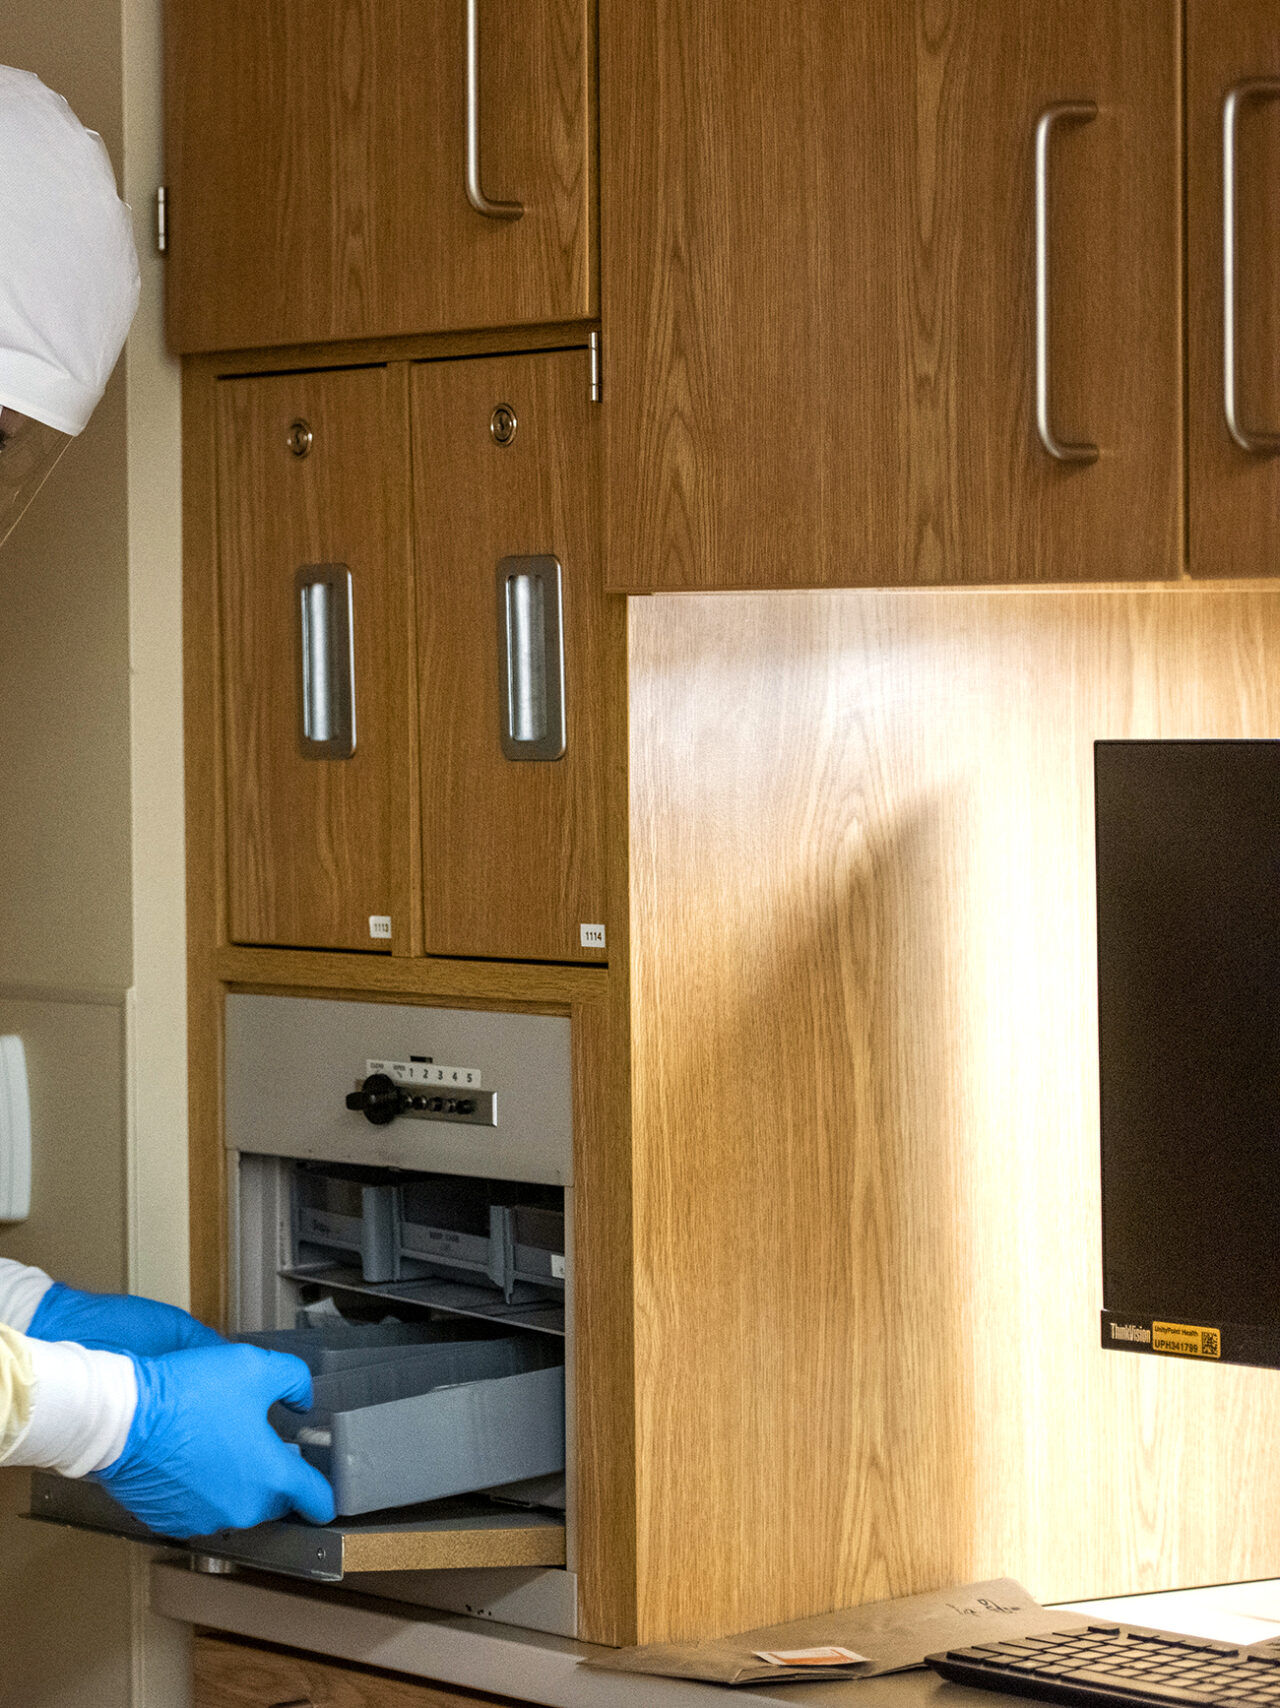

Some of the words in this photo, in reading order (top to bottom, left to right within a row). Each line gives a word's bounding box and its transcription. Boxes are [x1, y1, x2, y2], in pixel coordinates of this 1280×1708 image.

[585, 931, 602, 941] 1114
[409, 1068, 414, 1078] 1
[423, 1069, 429, 1079] 2
[438, 1070, 444, 1080] 3
[452, 1071, 458, 1081] 4
[466, 1073, 473, 1083] 5
[1110, 1322, 1151, 1344] ThinkVision
[1182, 1329, 1199, 1338] Health
